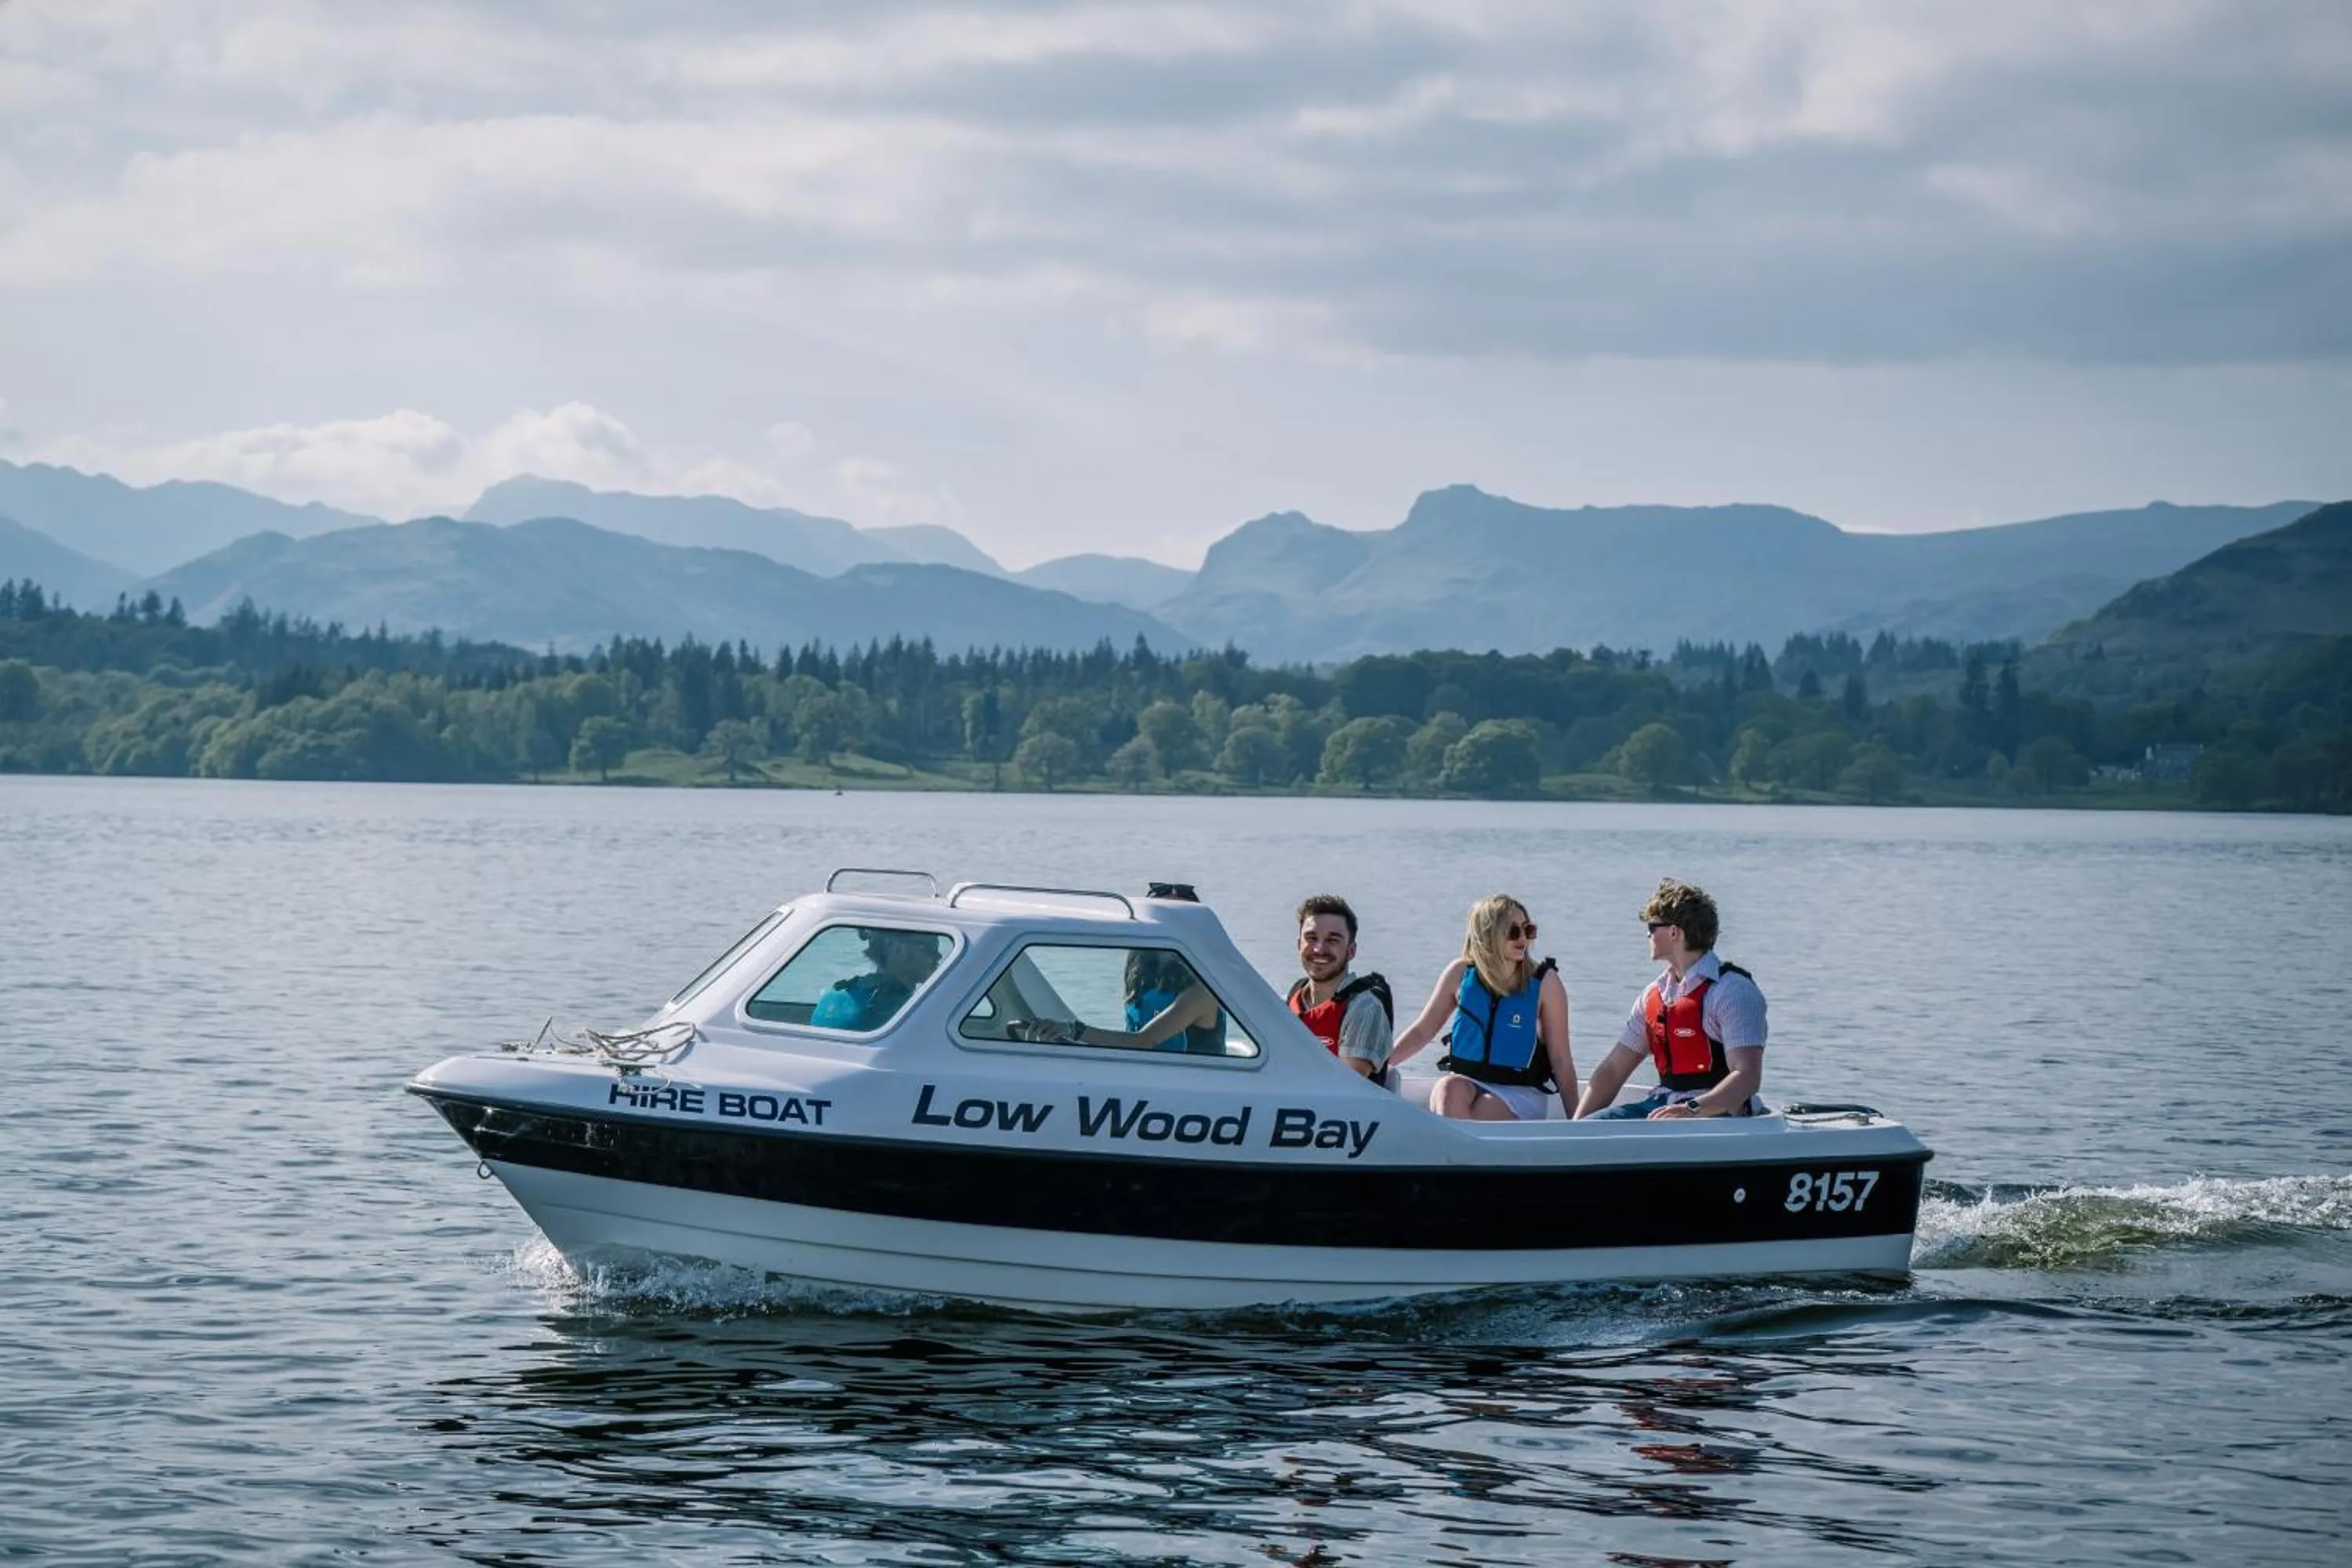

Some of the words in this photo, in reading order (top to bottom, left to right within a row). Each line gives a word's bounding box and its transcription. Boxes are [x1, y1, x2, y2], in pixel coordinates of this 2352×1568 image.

[608, 1083, 705, 1114] HIRE
[719, 1092, 832, 1126] BOAT
[913, 1084, 1053, 1132] Low
[1078, 1095, 1251, 1145] Wood
[1269, 1108, 1379, 1159] Bay
[1784, 1171, 1880, 1213] 8157
